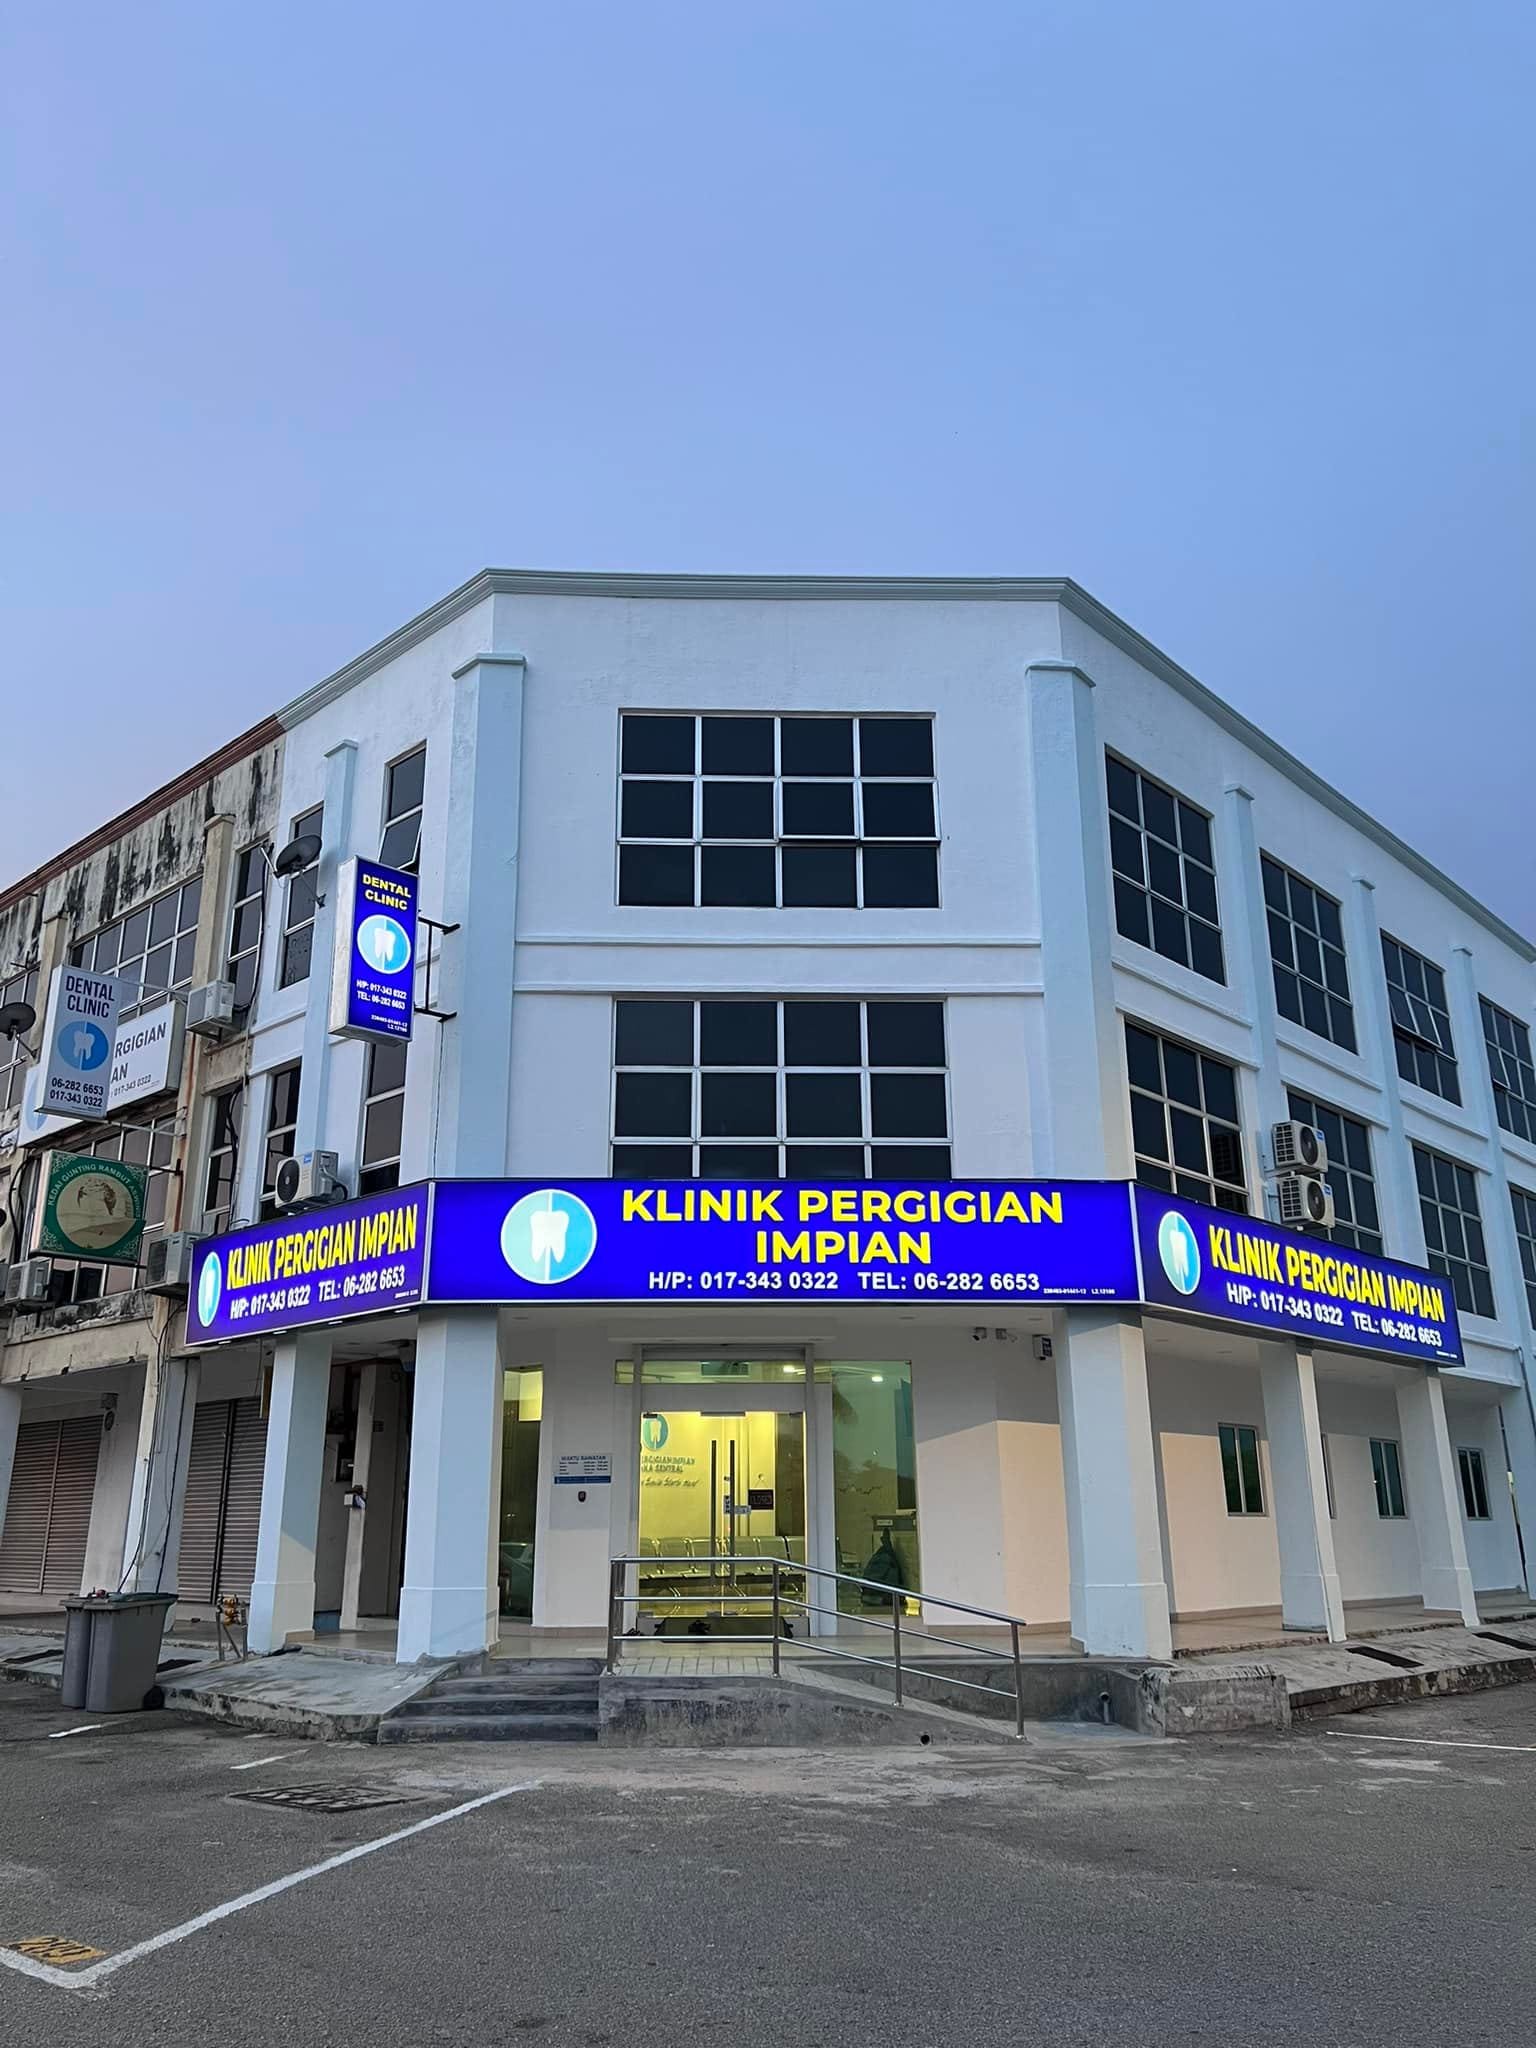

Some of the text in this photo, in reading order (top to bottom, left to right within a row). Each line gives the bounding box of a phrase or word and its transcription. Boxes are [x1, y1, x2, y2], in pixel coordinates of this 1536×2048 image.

[362, 873, 411, 898] DENTAL
[364, 889, 408, 911] CLINIC
[65, 975, 115, 1002] DENTAL
[357, 990, 371, 1002] TEL:
[67, 994, 110, 1018] CLINIC
[114, 1022, 167, 1059] RGIGIAN
[49, 1089, 103, 1107] 017-343 0322
[51, 1077, 104, 1096] 06-282 6653
[113, 1080, 137, 1096] 017-343
[137, 1074, 152, 1089] 0322
[47, 1163, 130, 1207] KEDAI GUNTING RAMBUT
[622, 1189, 1063, 1224] KLINIK PERGIGIAN
[226, 1203, 418, 1290] KLINIK PERGIGIAN IMPIAN
[756, 1230, 931, 1264] IMPIAN
[649, 1271, 693, 1289] H/P:
[701, 1271, 782, 1290] 017-343
[789, 1271, 838, 1290] 0322
[857, 1272, 907, 1290] TEL:
[913, 1272, 984, 1290] 06-282
[990, 1273, 1040, 1291] 6653
[1208, 1224, 1446, 1322] KLINIK PERGIGIAN IMPIAN
[229, 1264, 405, 1320] H/P: 017-343 0322 TEL: 06-282 6653
[1226, 1282, 1443, 1348] H/P: 017-343 0322 TEL: 06-282 6653
